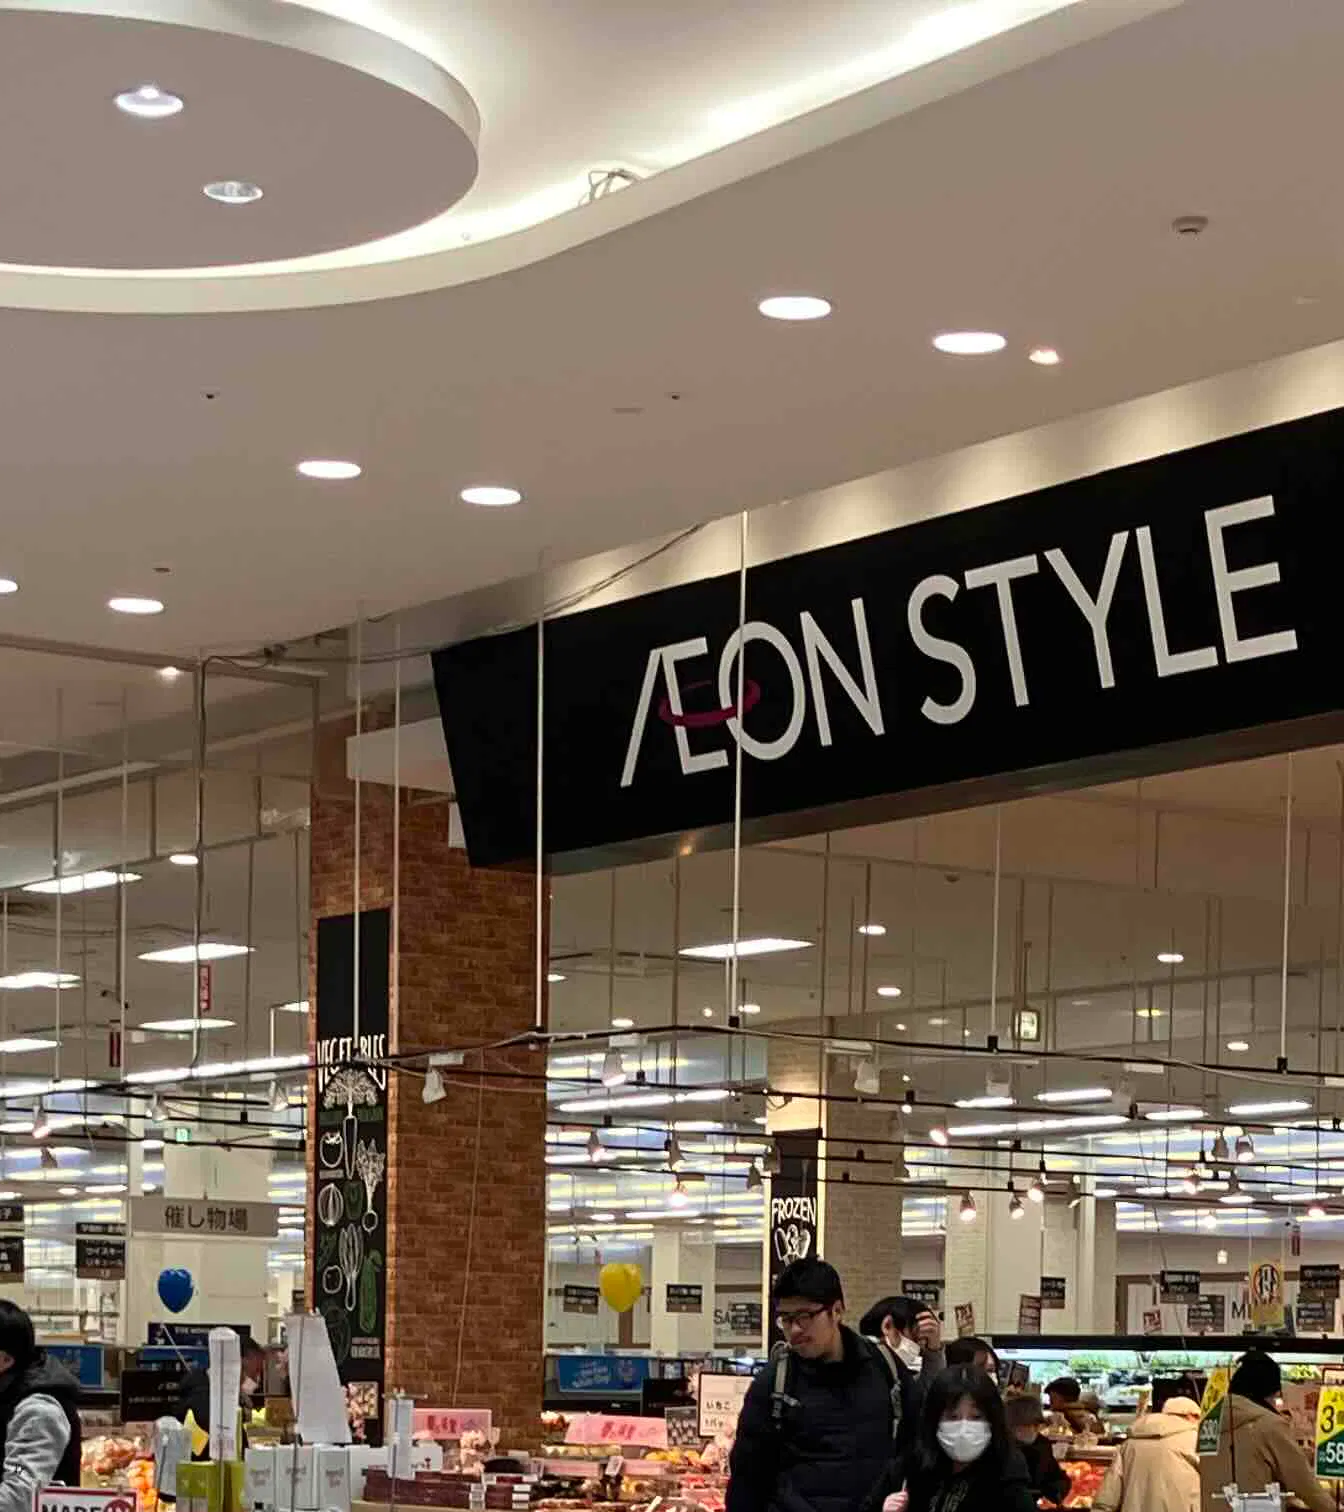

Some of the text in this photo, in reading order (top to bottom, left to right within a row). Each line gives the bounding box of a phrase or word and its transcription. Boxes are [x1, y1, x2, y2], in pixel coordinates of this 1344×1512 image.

[907, 494, 1299, 727] STYLE
[164, 1205, 249, 1231] 催し物場
[771, 1197, 816, 1229] FROZEN
